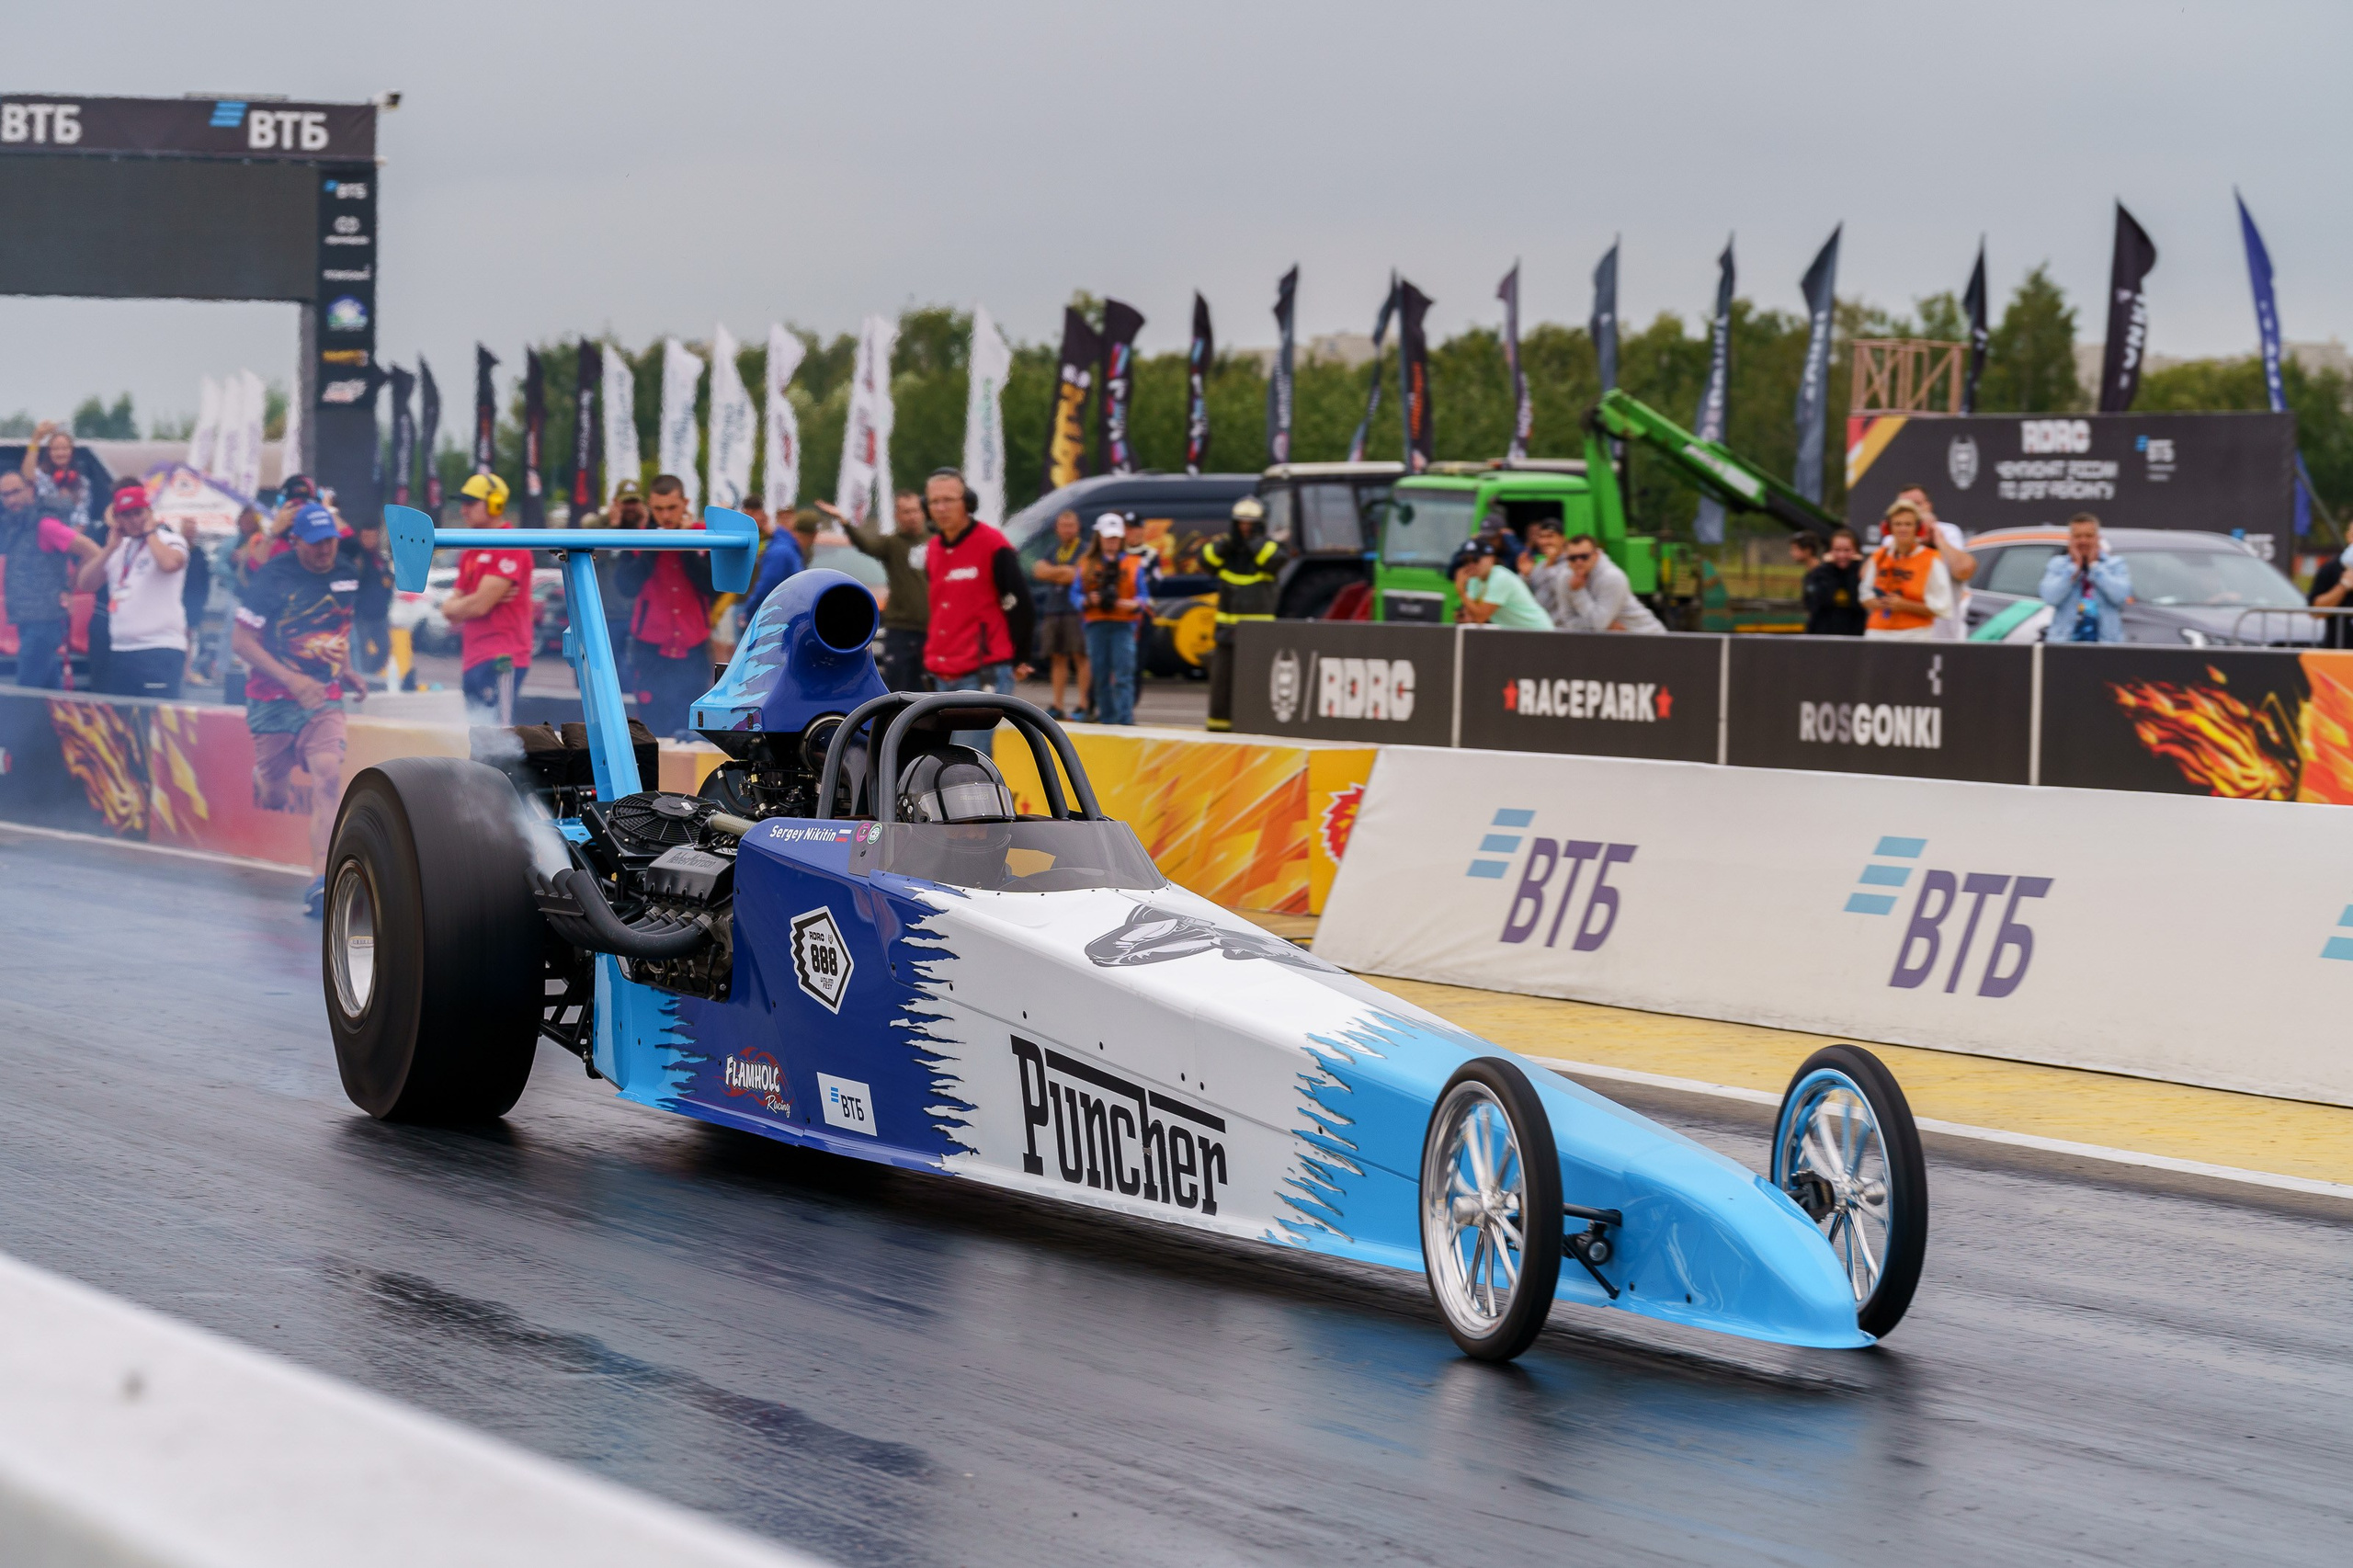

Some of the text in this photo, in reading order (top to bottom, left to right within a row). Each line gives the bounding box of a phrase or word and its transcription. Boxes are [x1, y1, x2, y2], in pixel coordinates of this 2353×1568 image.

[1, 103, 82, 143] ВТБ
[248, 109, 329, 152] ВТБ
[1318, 656, 1416, 722] RDRC
[1518, 678, 1657, 722] RACEPARK
[1799, 700, 1943, 750] ROSGONKI
[769, 824, 837, 843] Sergey Nikitin
[1500, 836, 1639, 953] ВТБ
[809, 930, 825, 942] RDRC
[1889, 868, 2054, 998] ВТБ
[810, 943, 838, 977] 888
[764, 1094, 791, 1119] Racing
[840, 1094, 865, 1121] ВТБ
[1009, 1033, 1229, 1217] Puncher
